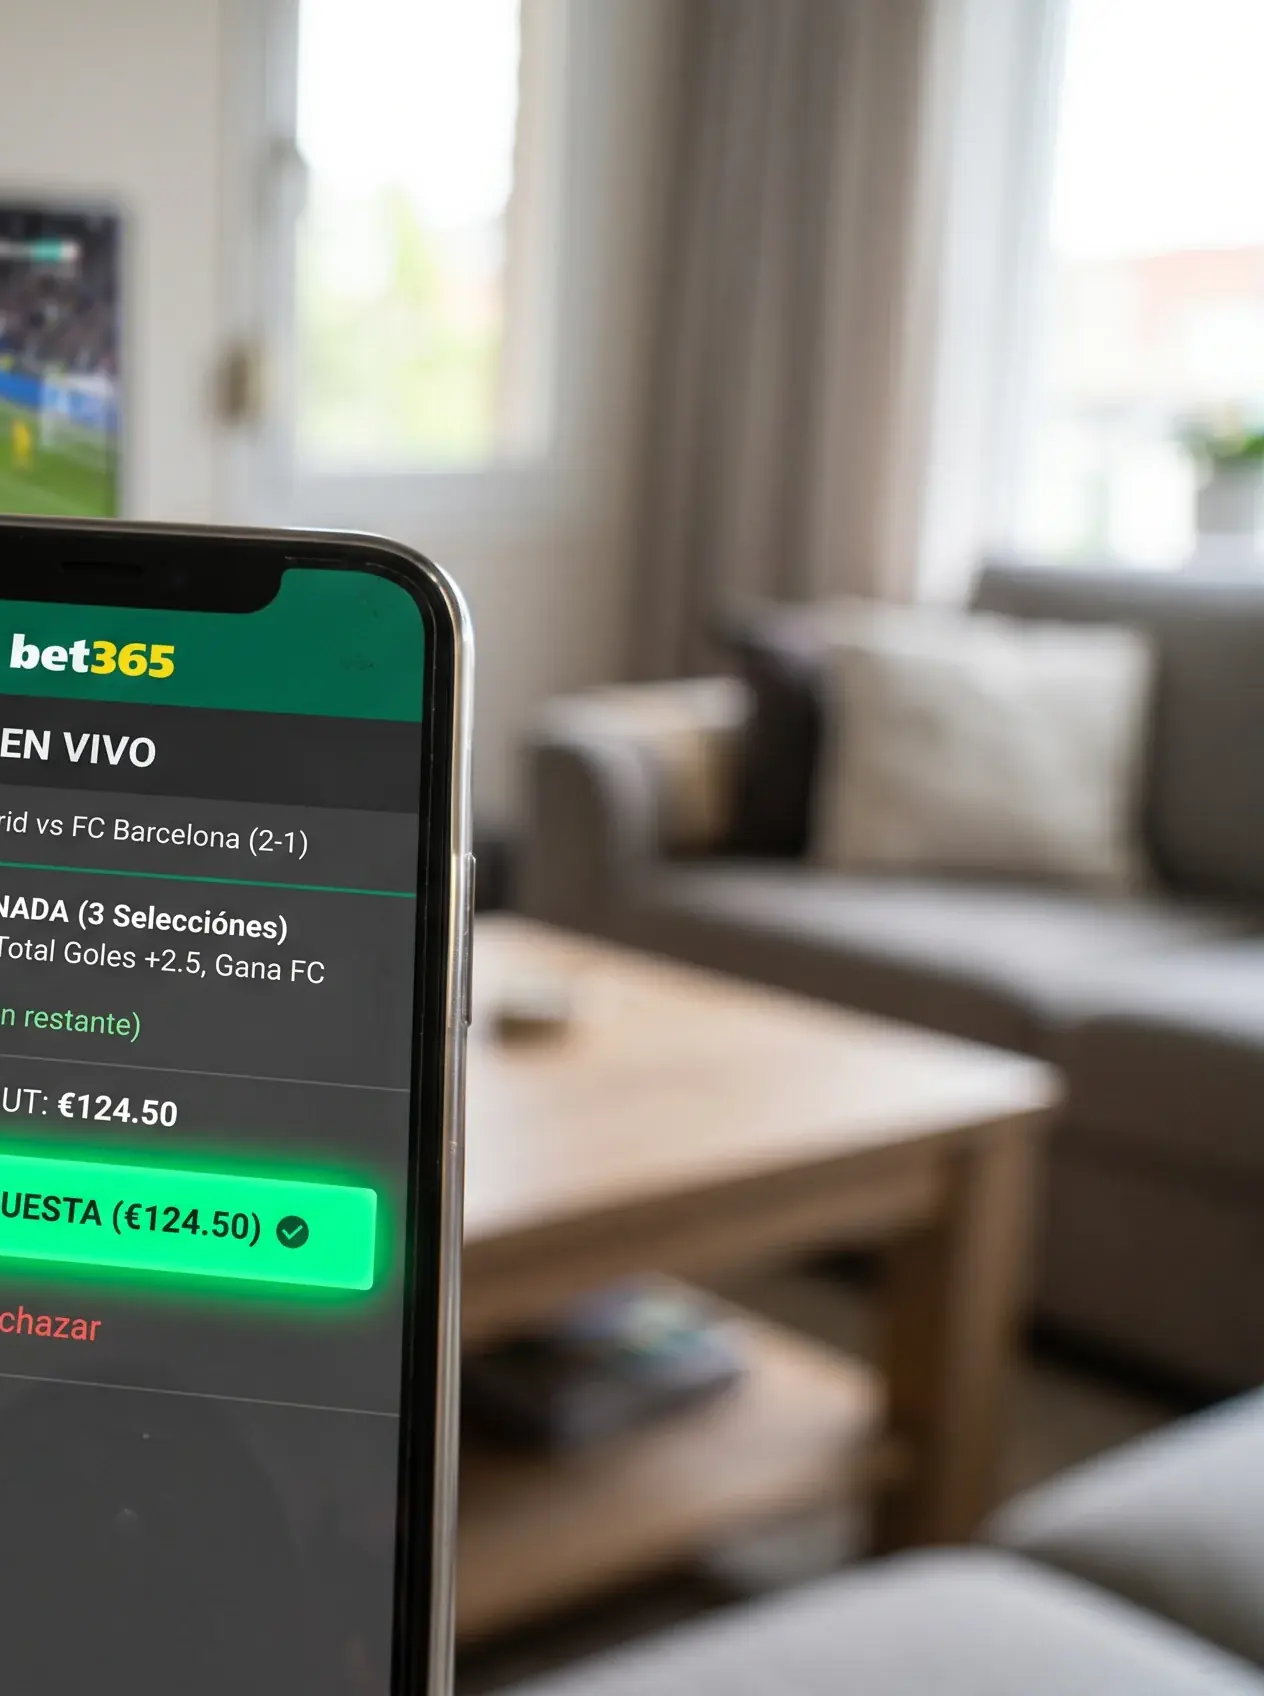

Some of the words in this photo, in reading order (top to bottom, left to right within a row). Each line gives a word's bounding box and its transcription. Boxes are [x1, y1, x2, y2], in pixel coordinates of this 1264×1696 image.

[9, 633, 175, 679] bet365
[0, 727, 51, 761] EN
[63, 731, 156, 768] VIVO
[36, 817, 64, 836] vs
[72, 815, 106, 839] FC
[113, 818, 240, 850] Barcelona
[249, 826, 308, 860] (2-1)
[78, 899, 105, 931] (3
[112, 903, 288, 946] Selecciónes)
[64, 941, 136, 969] Goles
[144, 948, 206, 979] +2.5,
[215, 953, 281, 981] Gana
[290, 959, 325, 984] FC
[24, 1009, 141, 1043] restante)
[57, 1092, 178, 1127] €124.50
[112, 1199, 261, 1248] (€124.50)
